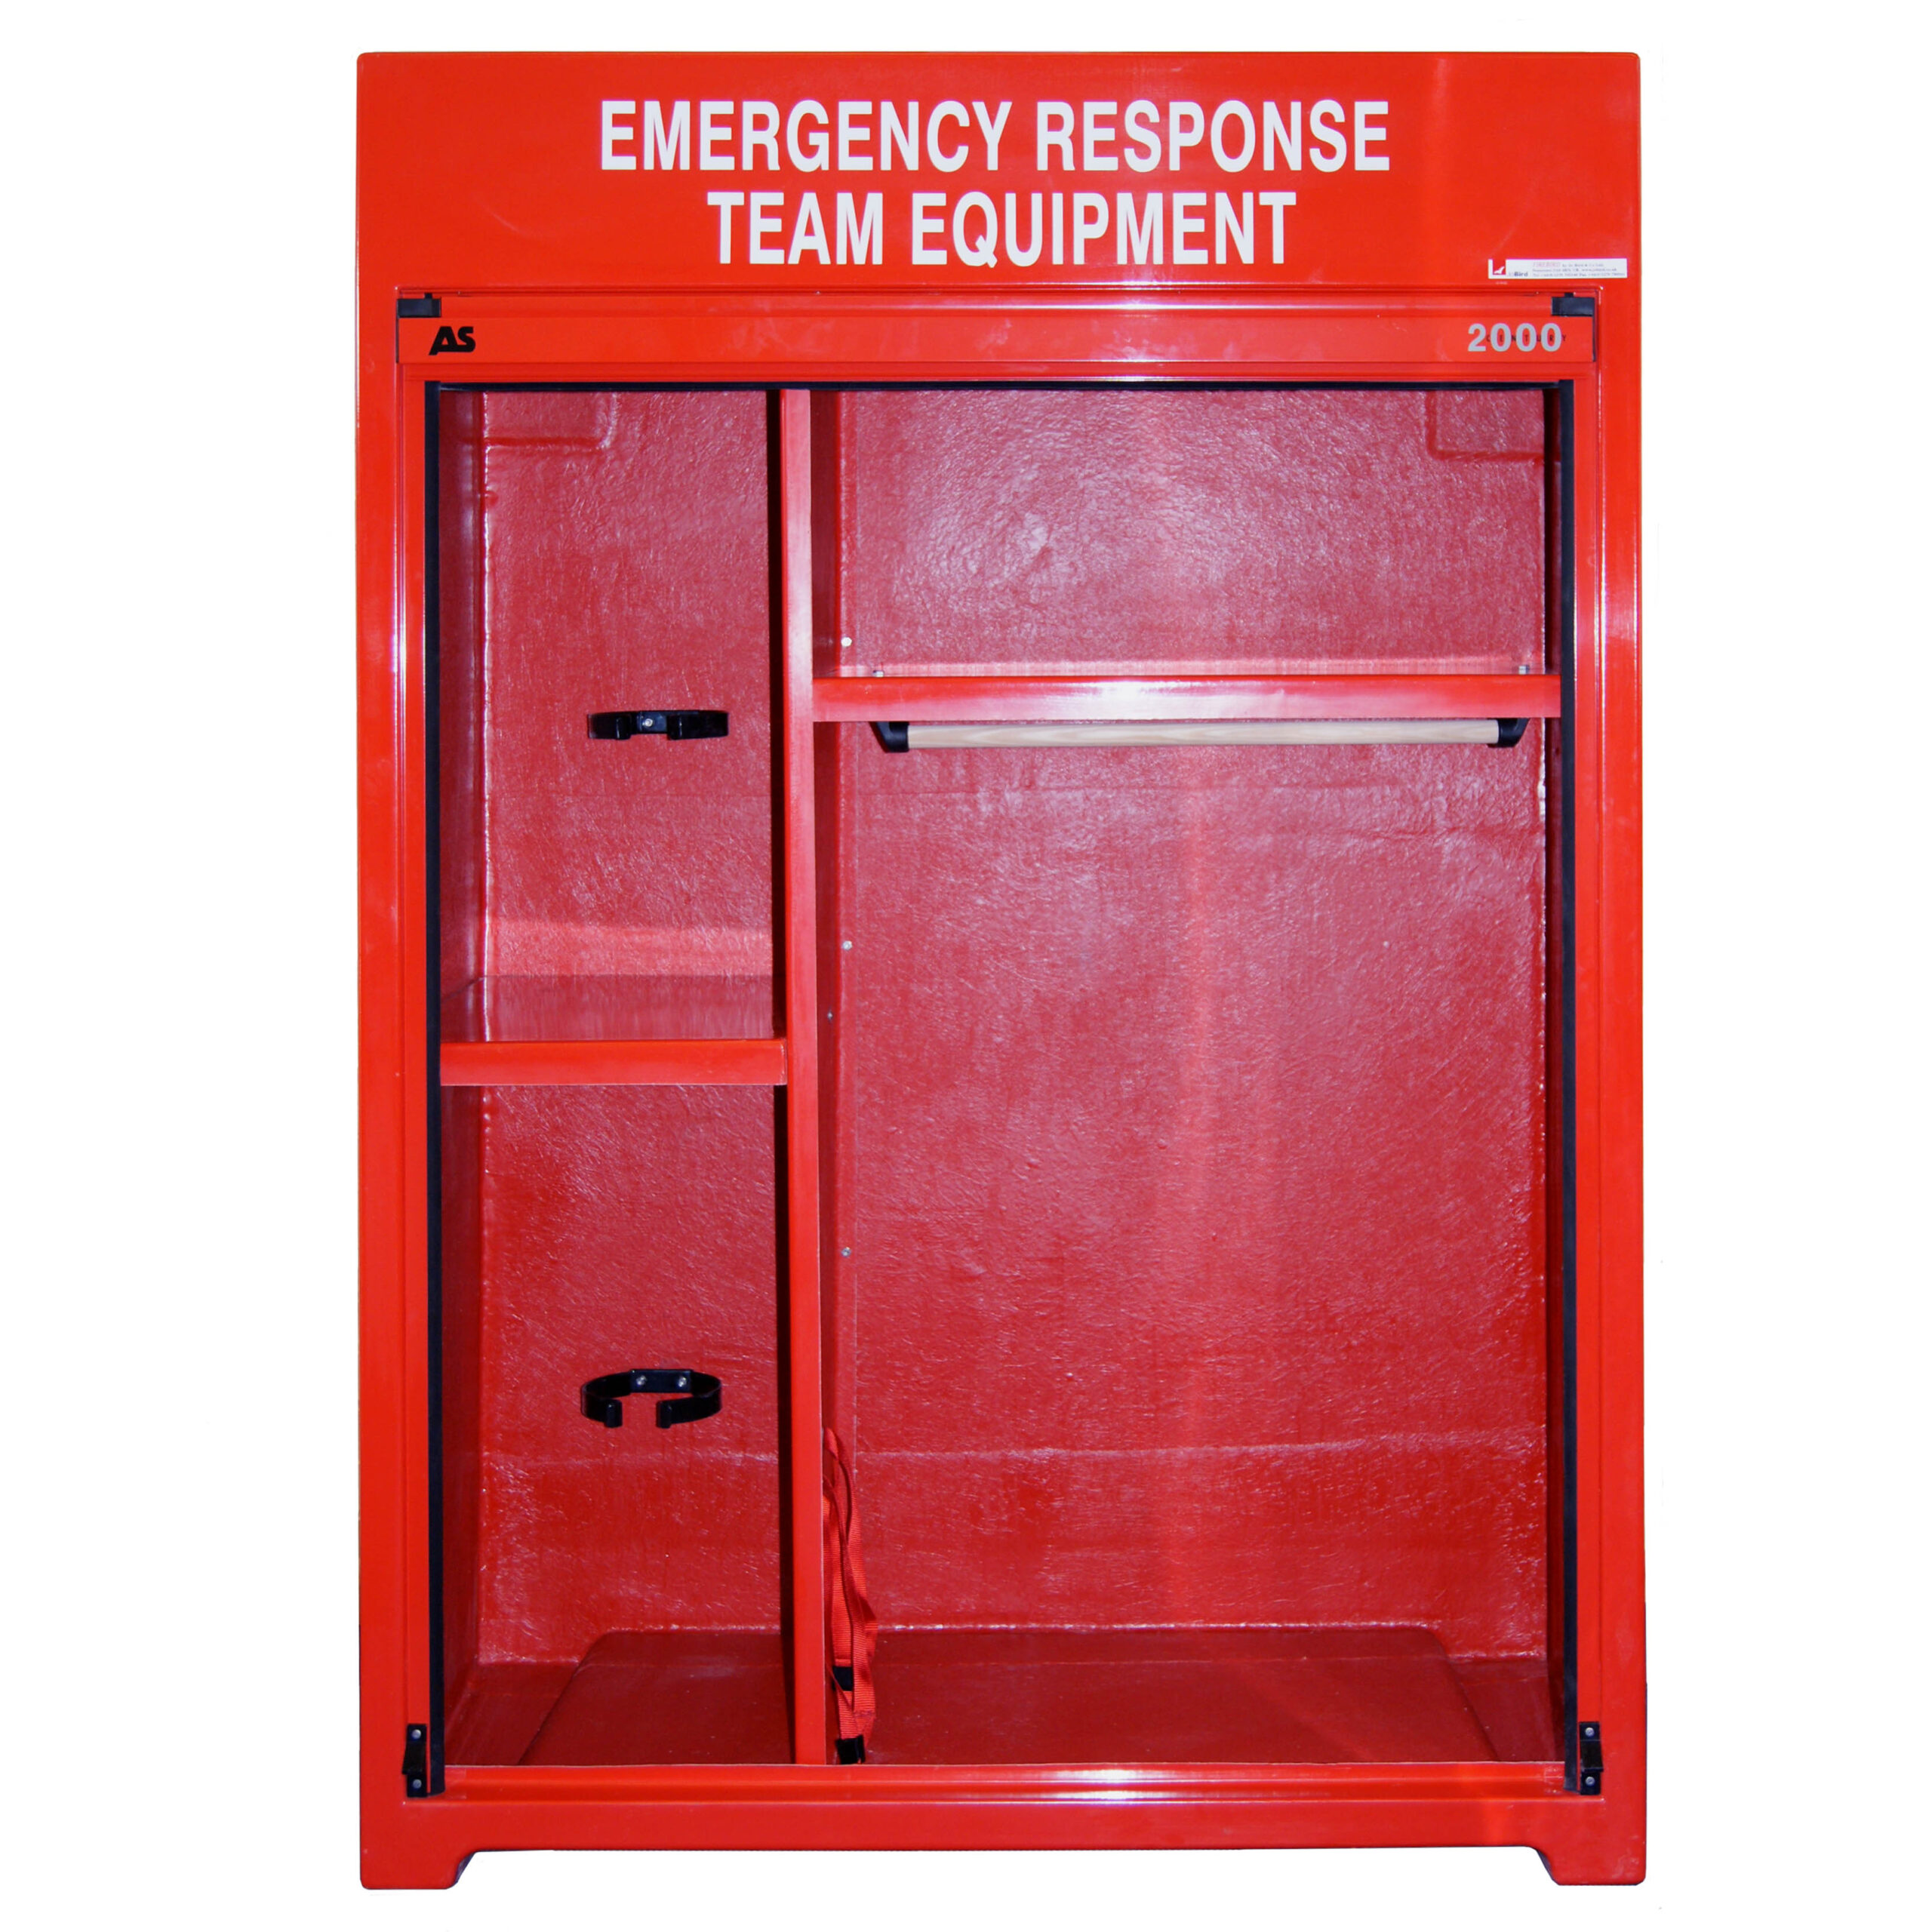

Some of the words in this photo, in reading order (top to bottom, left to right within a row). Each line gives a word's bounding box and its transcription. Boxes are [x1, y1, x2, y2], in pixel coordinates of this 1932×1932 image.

[600, 99, 1013, 173] EMERGENCY
[1035, 99, 1390, 173] RESPONSE
[706, 191, 884, 265] TEAM
[912, 191, 1297, 268] EQUIPMENT
[429, 326, 476, 355] AS
[1467, 322, 1562, 352] 2000
